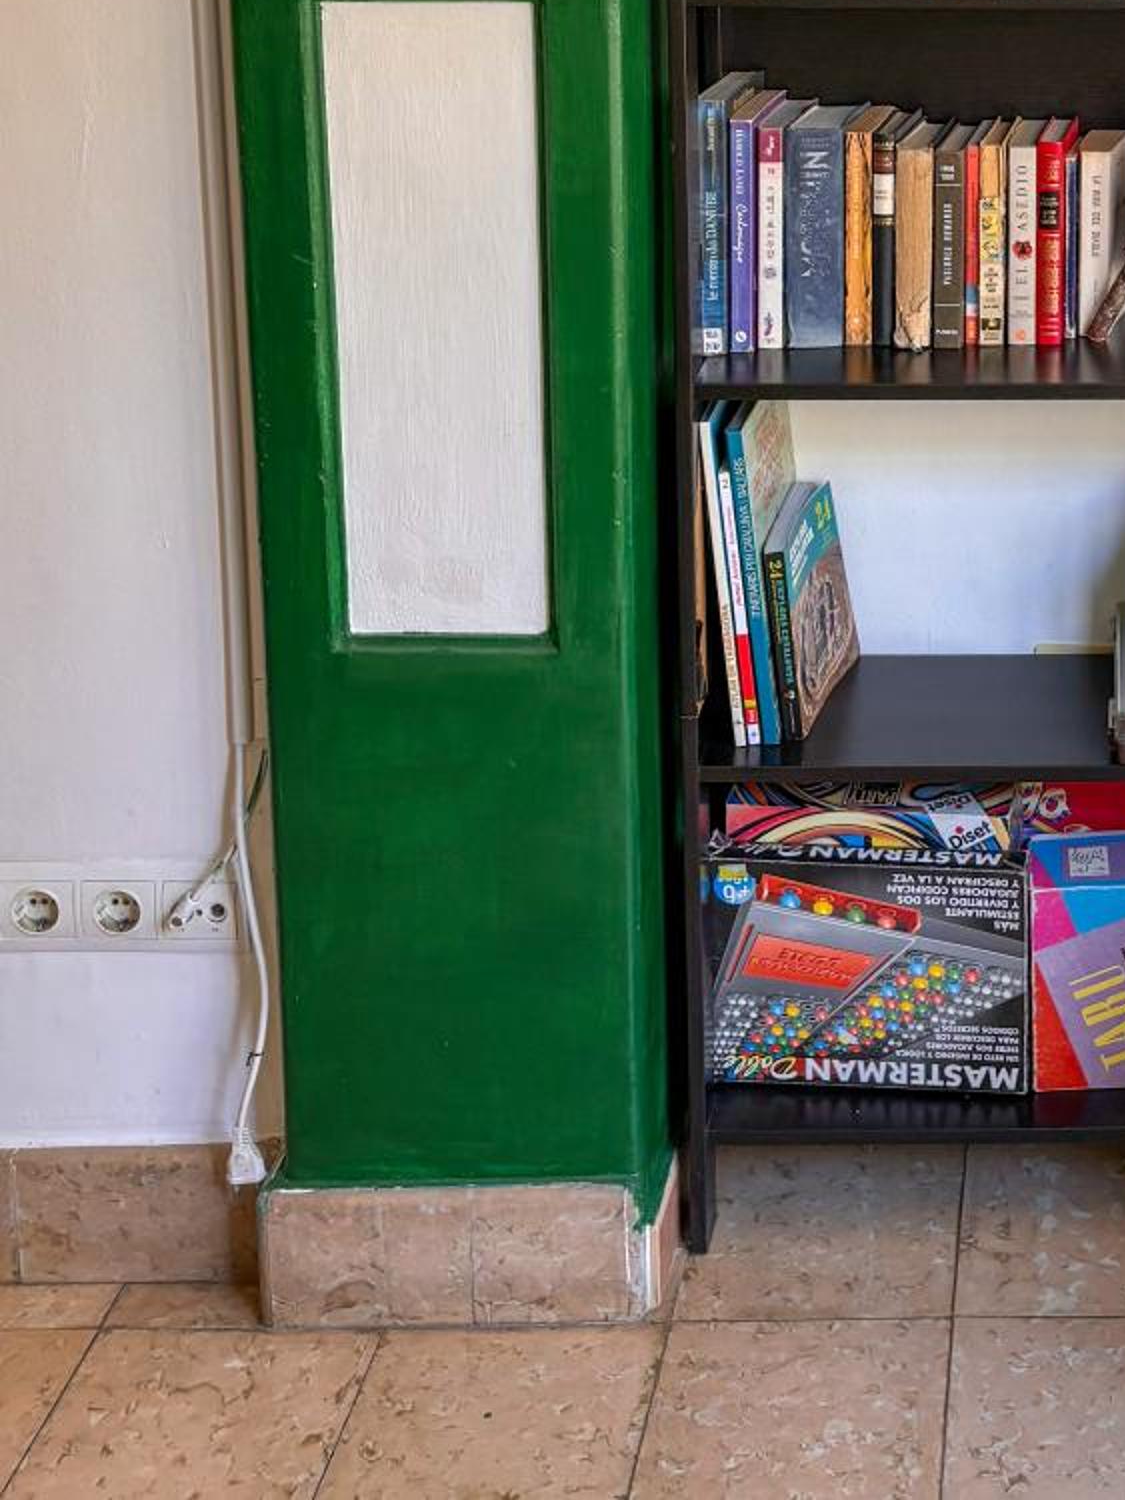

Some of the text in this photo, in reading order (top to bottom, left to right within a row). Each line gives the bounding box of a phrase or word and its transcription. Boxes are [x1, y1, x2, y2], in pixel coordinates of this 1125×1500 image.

[1015, 165, 1028, 285] EL ASEDIO
[947, 821, 992, 850] Diset
[809, 846, 1003, 865] MASTERMAN
[892, 874, 1020, 888] Y DESCIFRAN A LA VEZ
[886, 884, 1020, 898] JUGADORES CODIFICAN
[896, 895, 1020, 909] Y DIVERTIDO LOS DOS
[945, 908, 1020, 920] ESTIMULANTE
[993, 920, 1020, 931] MÁS
[722, 1053, 1020, 1090] MASTERMAN Doble
